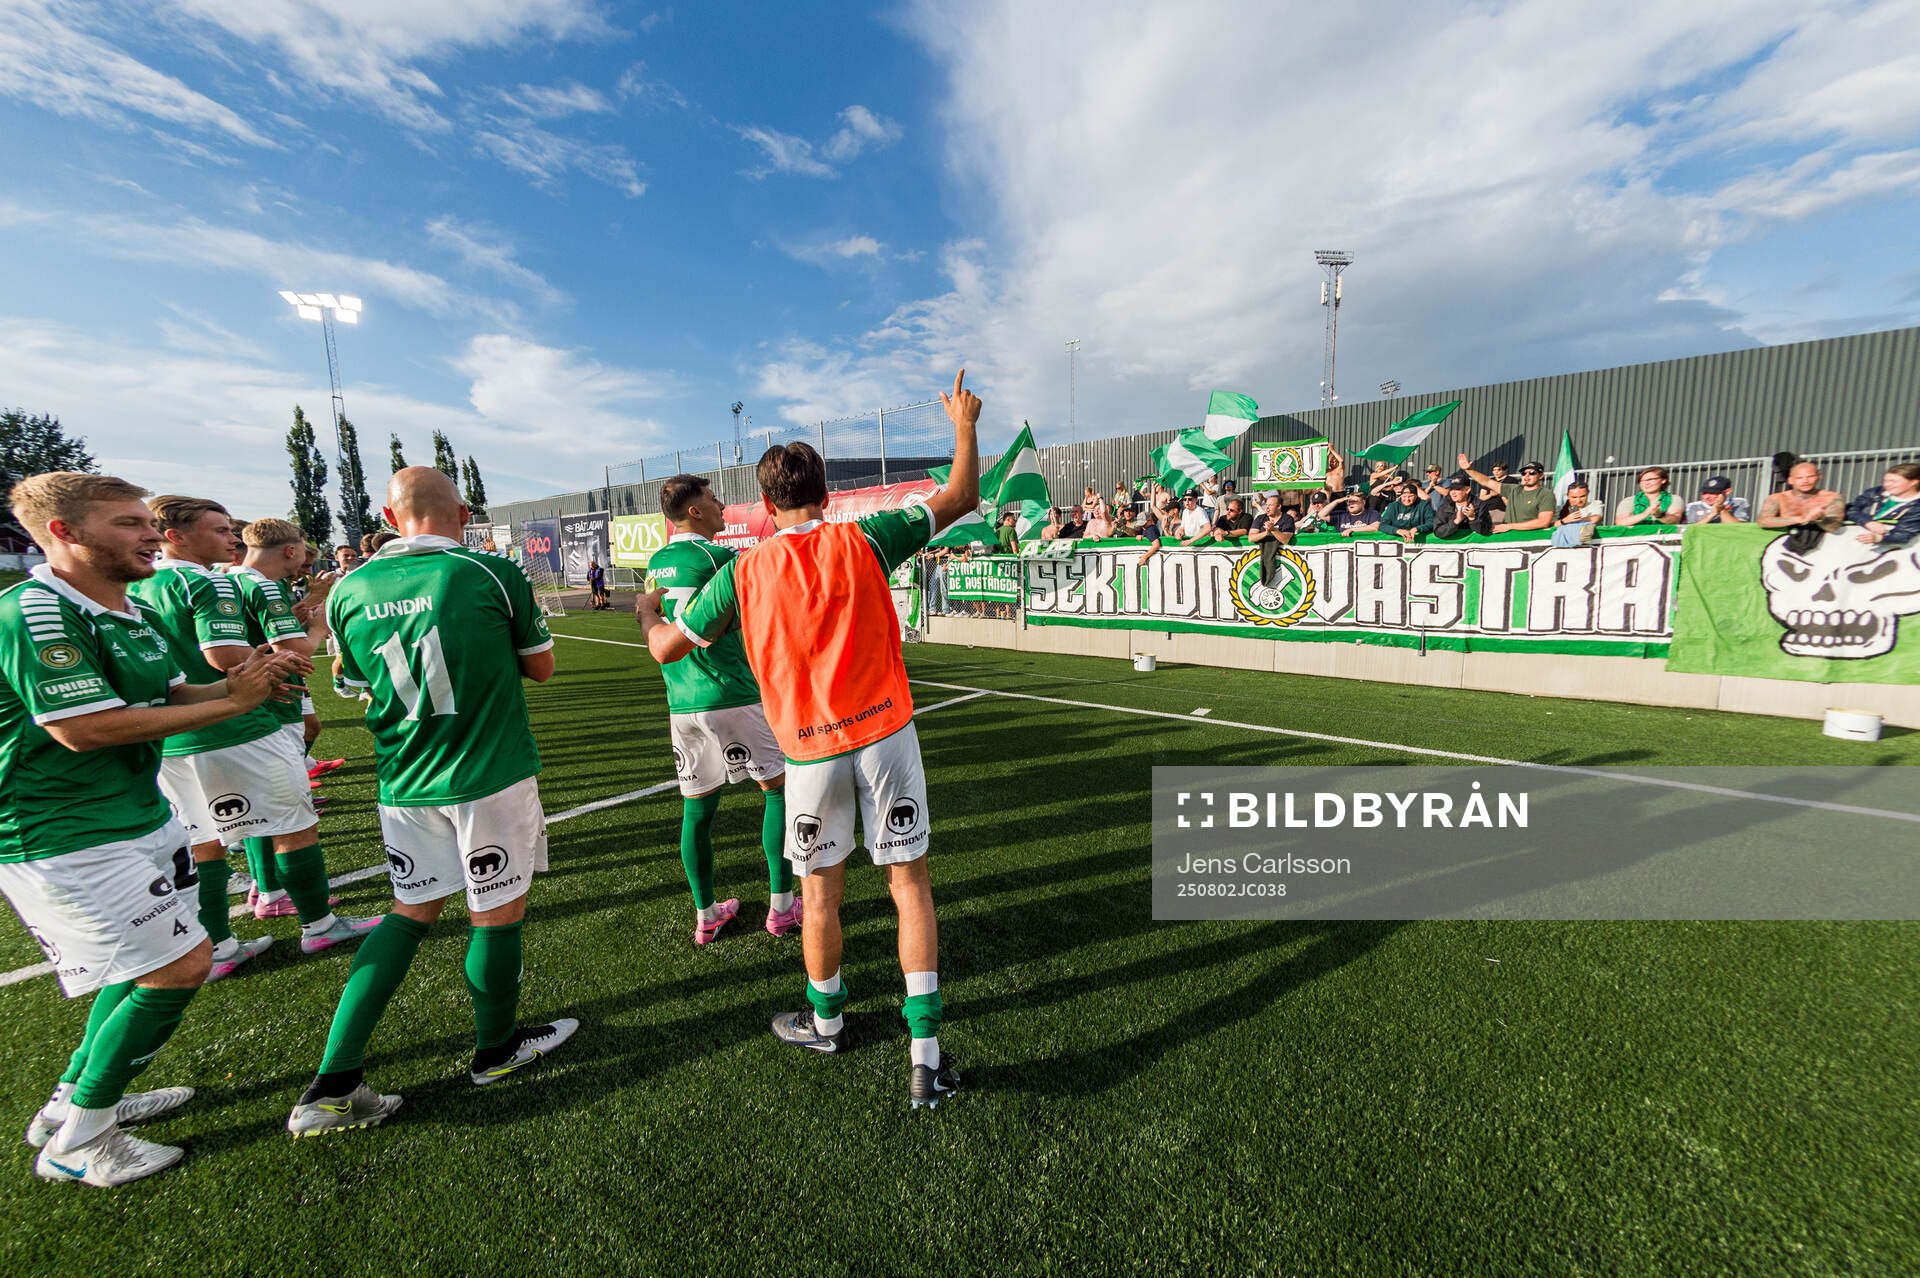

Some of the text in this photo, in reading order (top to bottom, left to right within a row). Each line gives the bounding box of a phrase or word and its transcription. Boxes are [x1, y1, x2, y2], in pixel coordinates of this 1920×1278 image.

[616, 522, 663, 551] RYDS
[949, 578, 962, 591] DE
[1028, 540, 1672, 634] SEKTION VÄSTRA
[364, 596, 433, 621] LUNDIN
[663, 586, 698, 618] 7
[44, 677, 104, 695] UNIBET
[372, 625, 459, 721] 11
[798, 697, 893, 740] All sports united
[469, 875, 522, 895] ODONTA
[173, 918, 189, 937] 4
